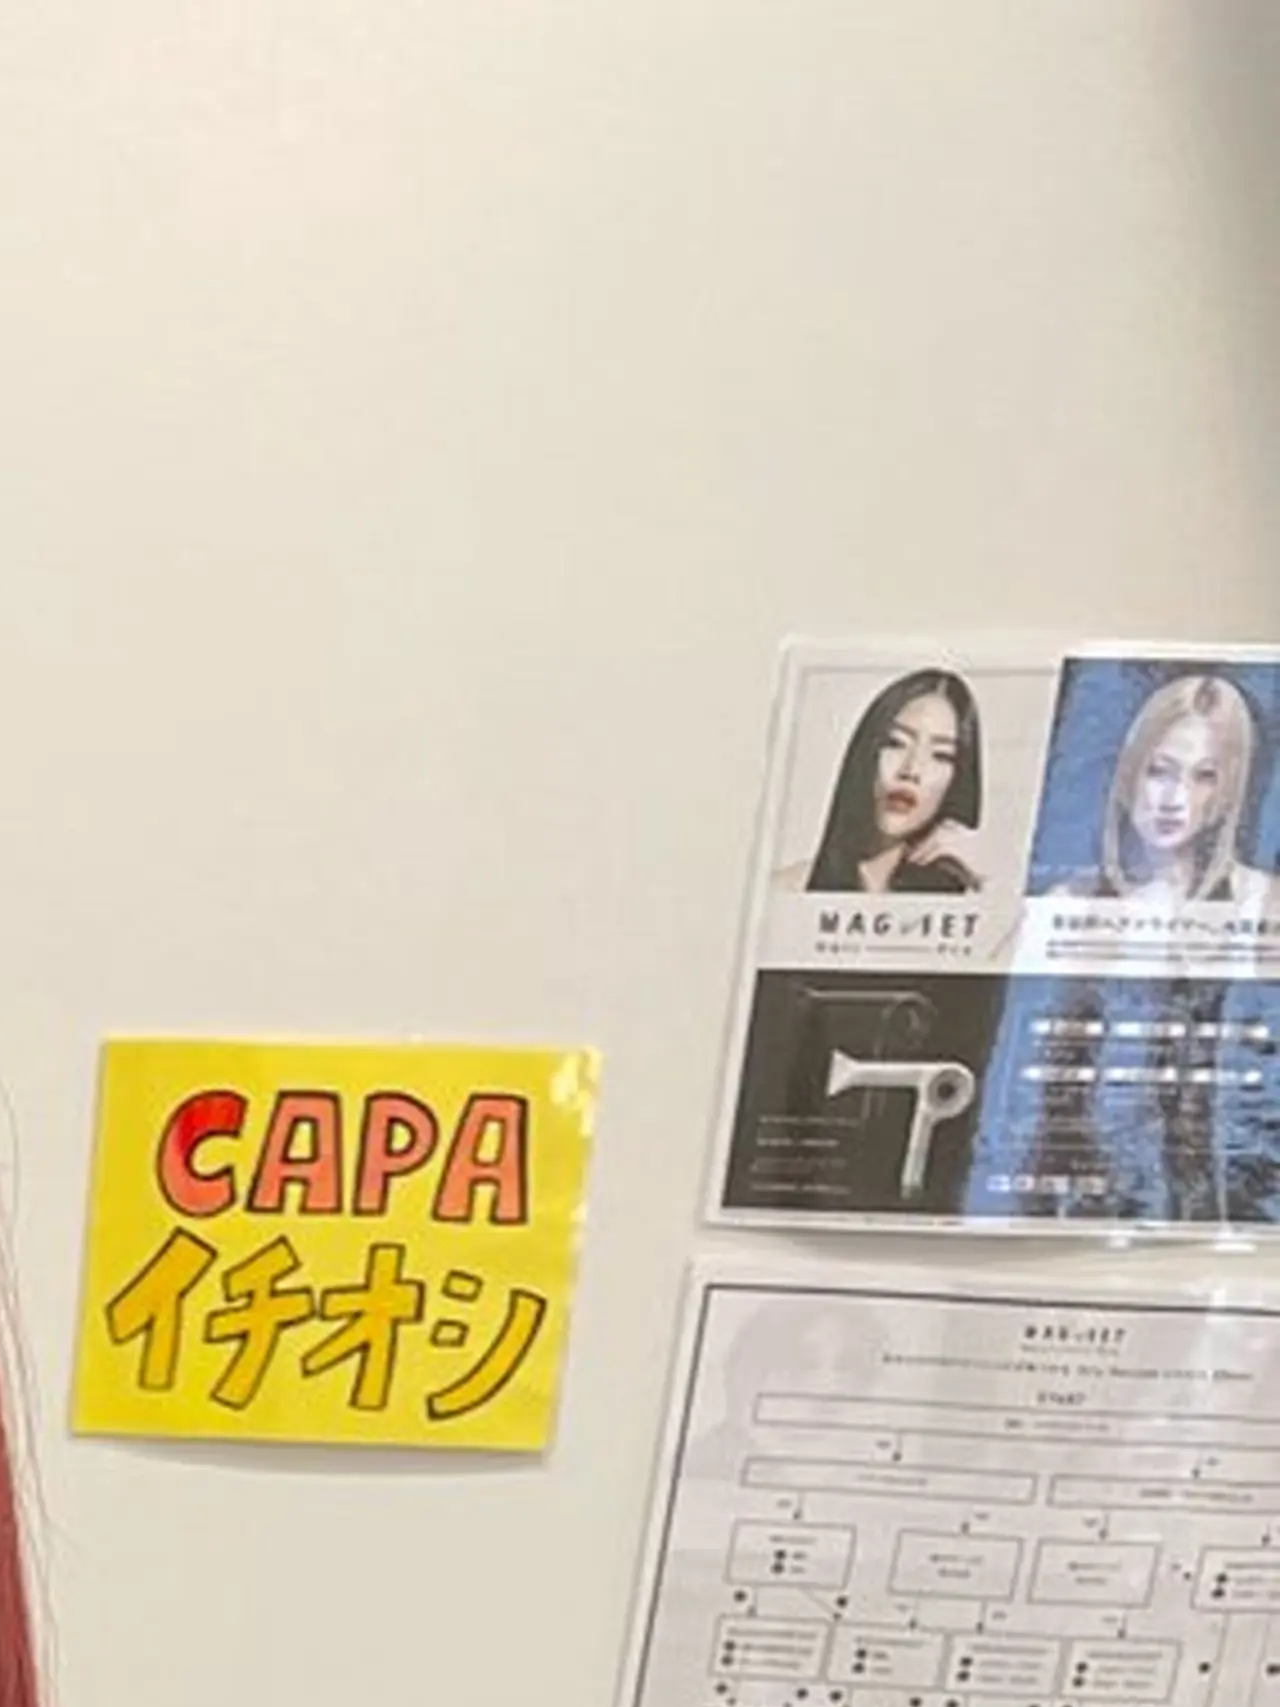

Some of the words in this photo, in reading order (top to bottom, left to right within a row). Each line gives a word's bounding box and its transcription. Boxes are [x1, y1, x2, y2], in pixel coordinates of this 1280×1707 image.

[155, 1088, 530, 1226] CAPA
[105, 1226, 548, 1421] イチオシ
